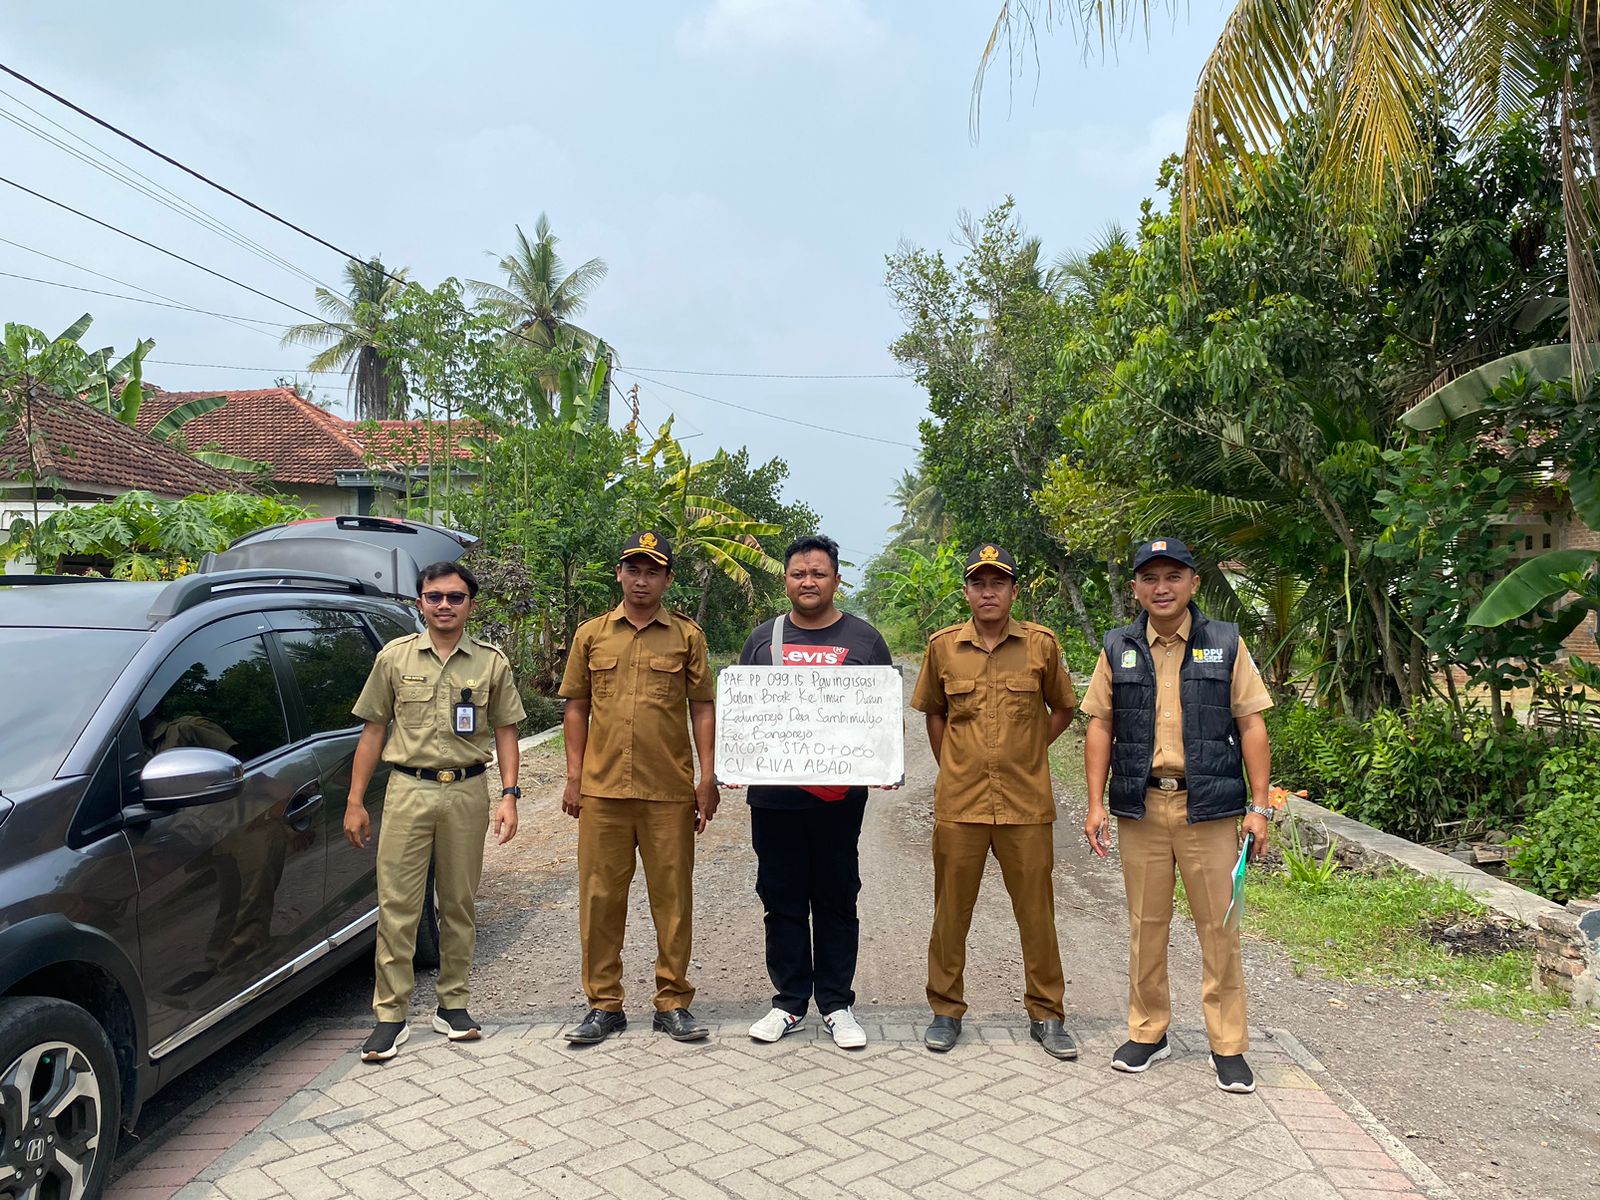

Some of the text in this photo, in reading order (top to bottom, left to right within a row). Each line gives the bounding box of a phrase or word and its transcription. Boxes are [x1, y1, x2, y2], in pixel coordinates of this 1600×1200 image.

[1203, 648, 1223, 656] DPU
[724, 671, 876, 690] PAK PP 099.15 Pavingisasi
[723, 687, 754, 706] Jalan
[761, 688, 791, 704] Brak
[816, 707, 883, 729] Sambimulyo
[752, 725, 813, 742] Bangorejo
[724, 756, 852, 775] CV RIVA ABADI
